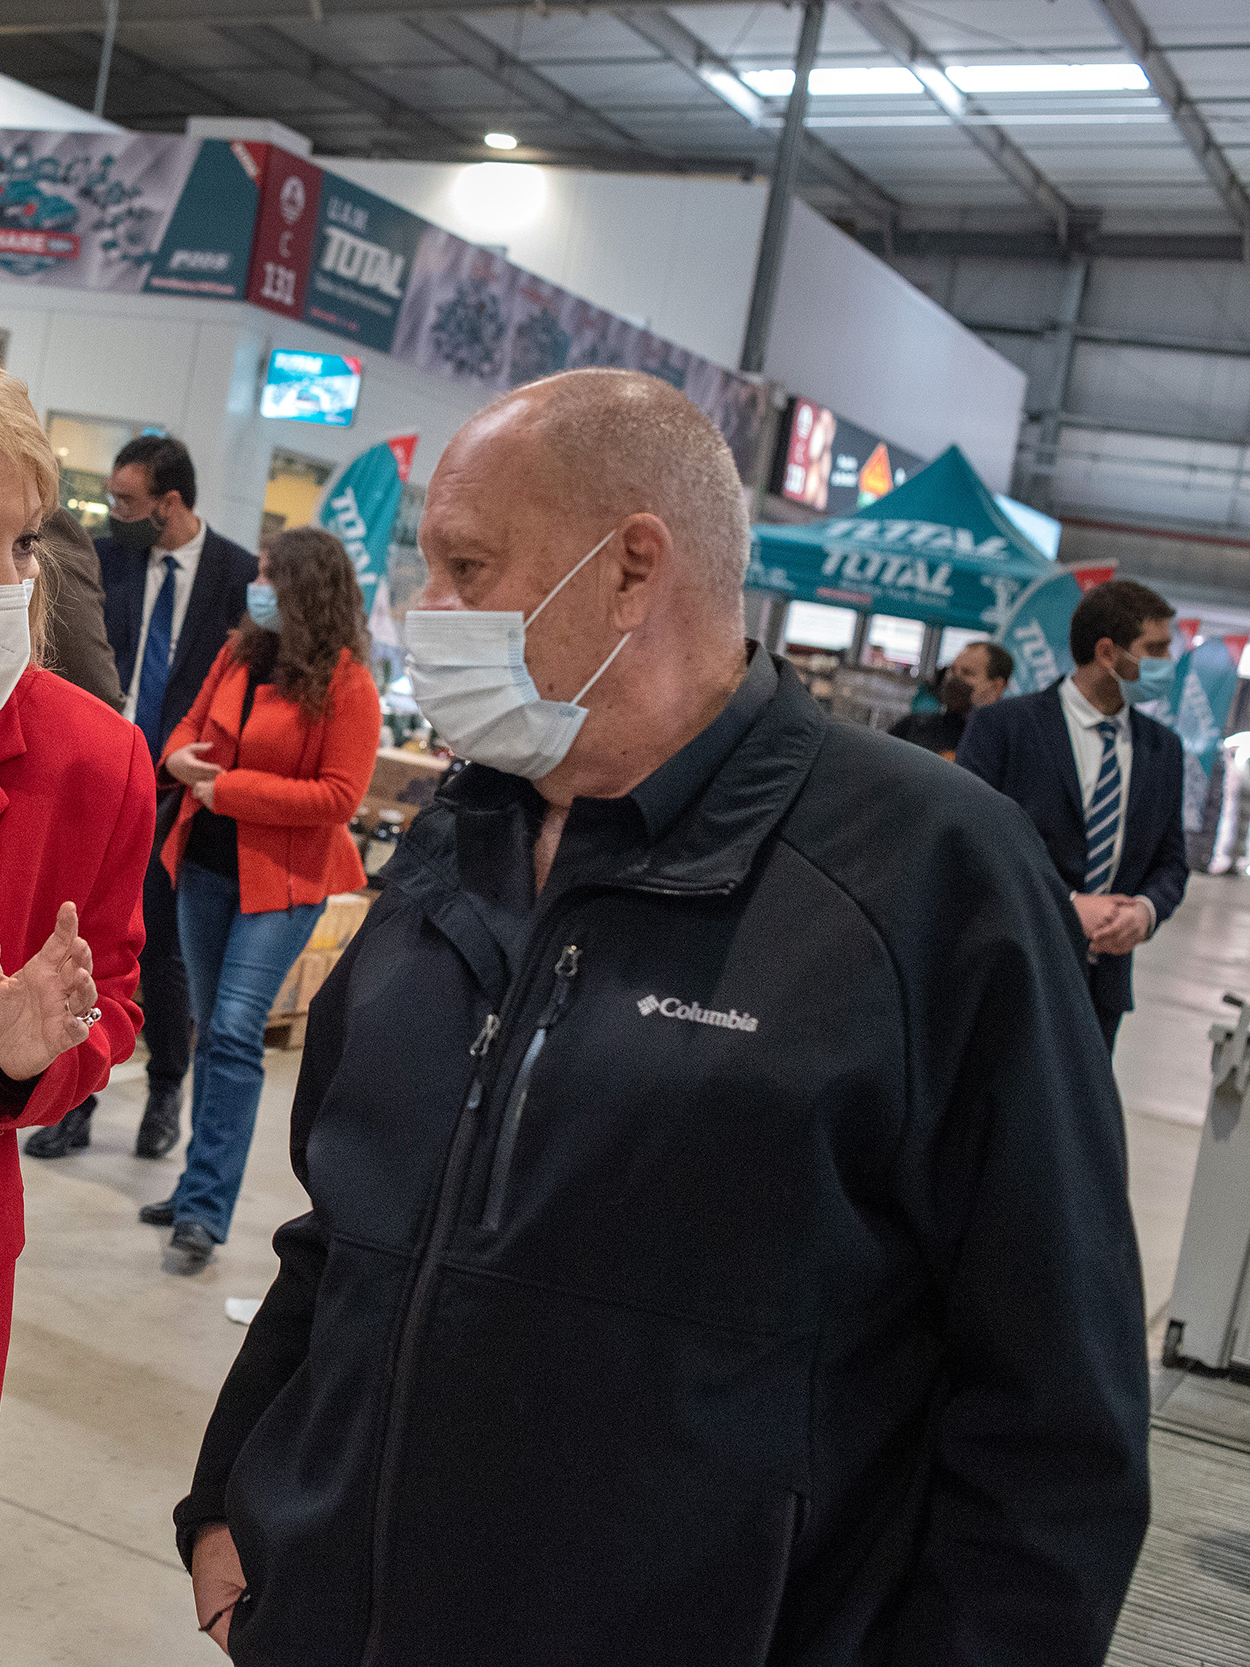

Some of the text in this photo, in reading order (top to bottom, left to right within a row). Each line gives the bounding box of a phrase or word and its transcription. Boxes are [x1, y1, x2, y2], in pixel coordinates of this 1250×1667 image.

[261, 261, 297, 306] 131
[321, 226, 407, 298] TOTAL
[821, 546, 954, 596] TOTAL
[659, 997, 759, 1032] Columbia
